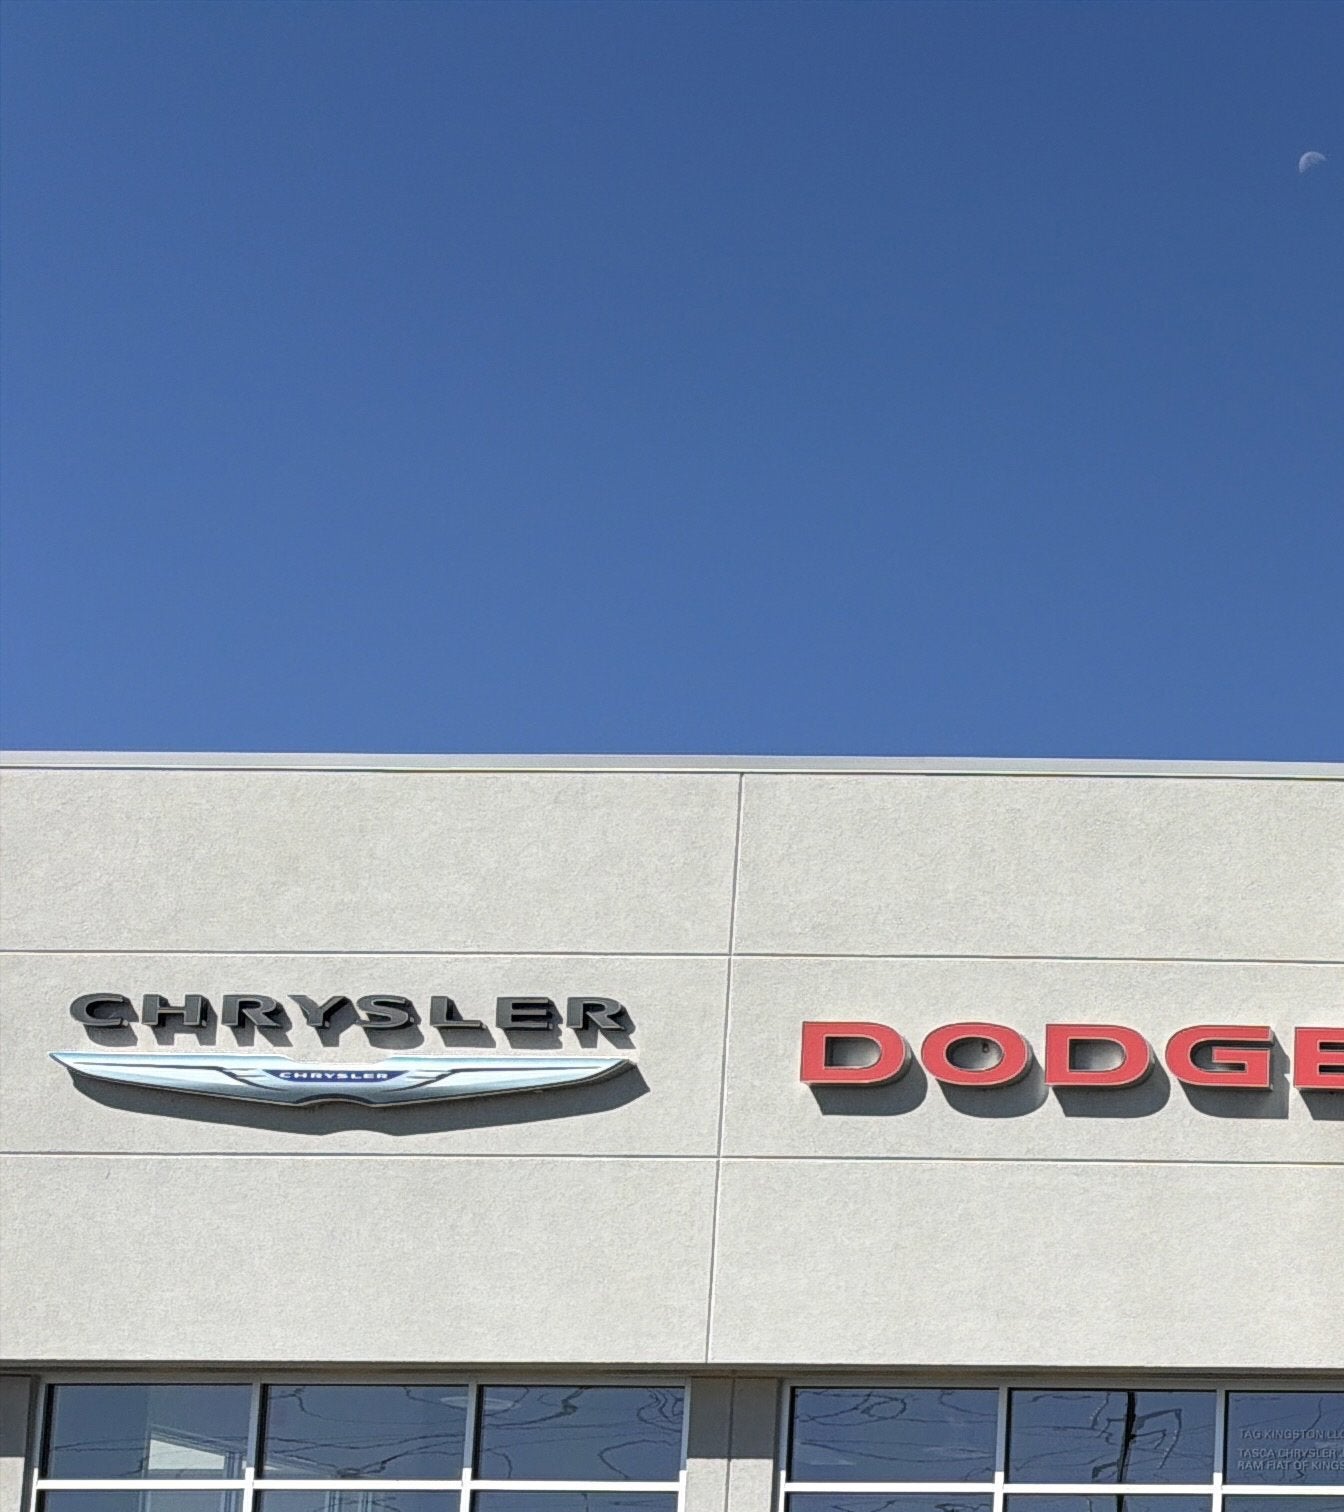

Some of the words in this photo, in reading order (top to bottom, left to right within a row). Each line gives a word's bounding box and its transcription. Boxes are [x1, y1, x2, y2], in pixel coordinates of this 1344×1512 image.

[69, 992, 628, 1032] CHRYSLER
[1240, 1429, 1262, 1439] TAG
[1264, 1429, 1324, 1440] KINGSTON
[1238, 1448, 1275, 1458] TASCA
[1278, 1448, 1337, 1459] CHRYSLER
[1237, 1460, 1264, 1471] RAM
[1266, 1460, 1292, 1471] FIAT
[1293, 1460, 1309, 1471] OF
